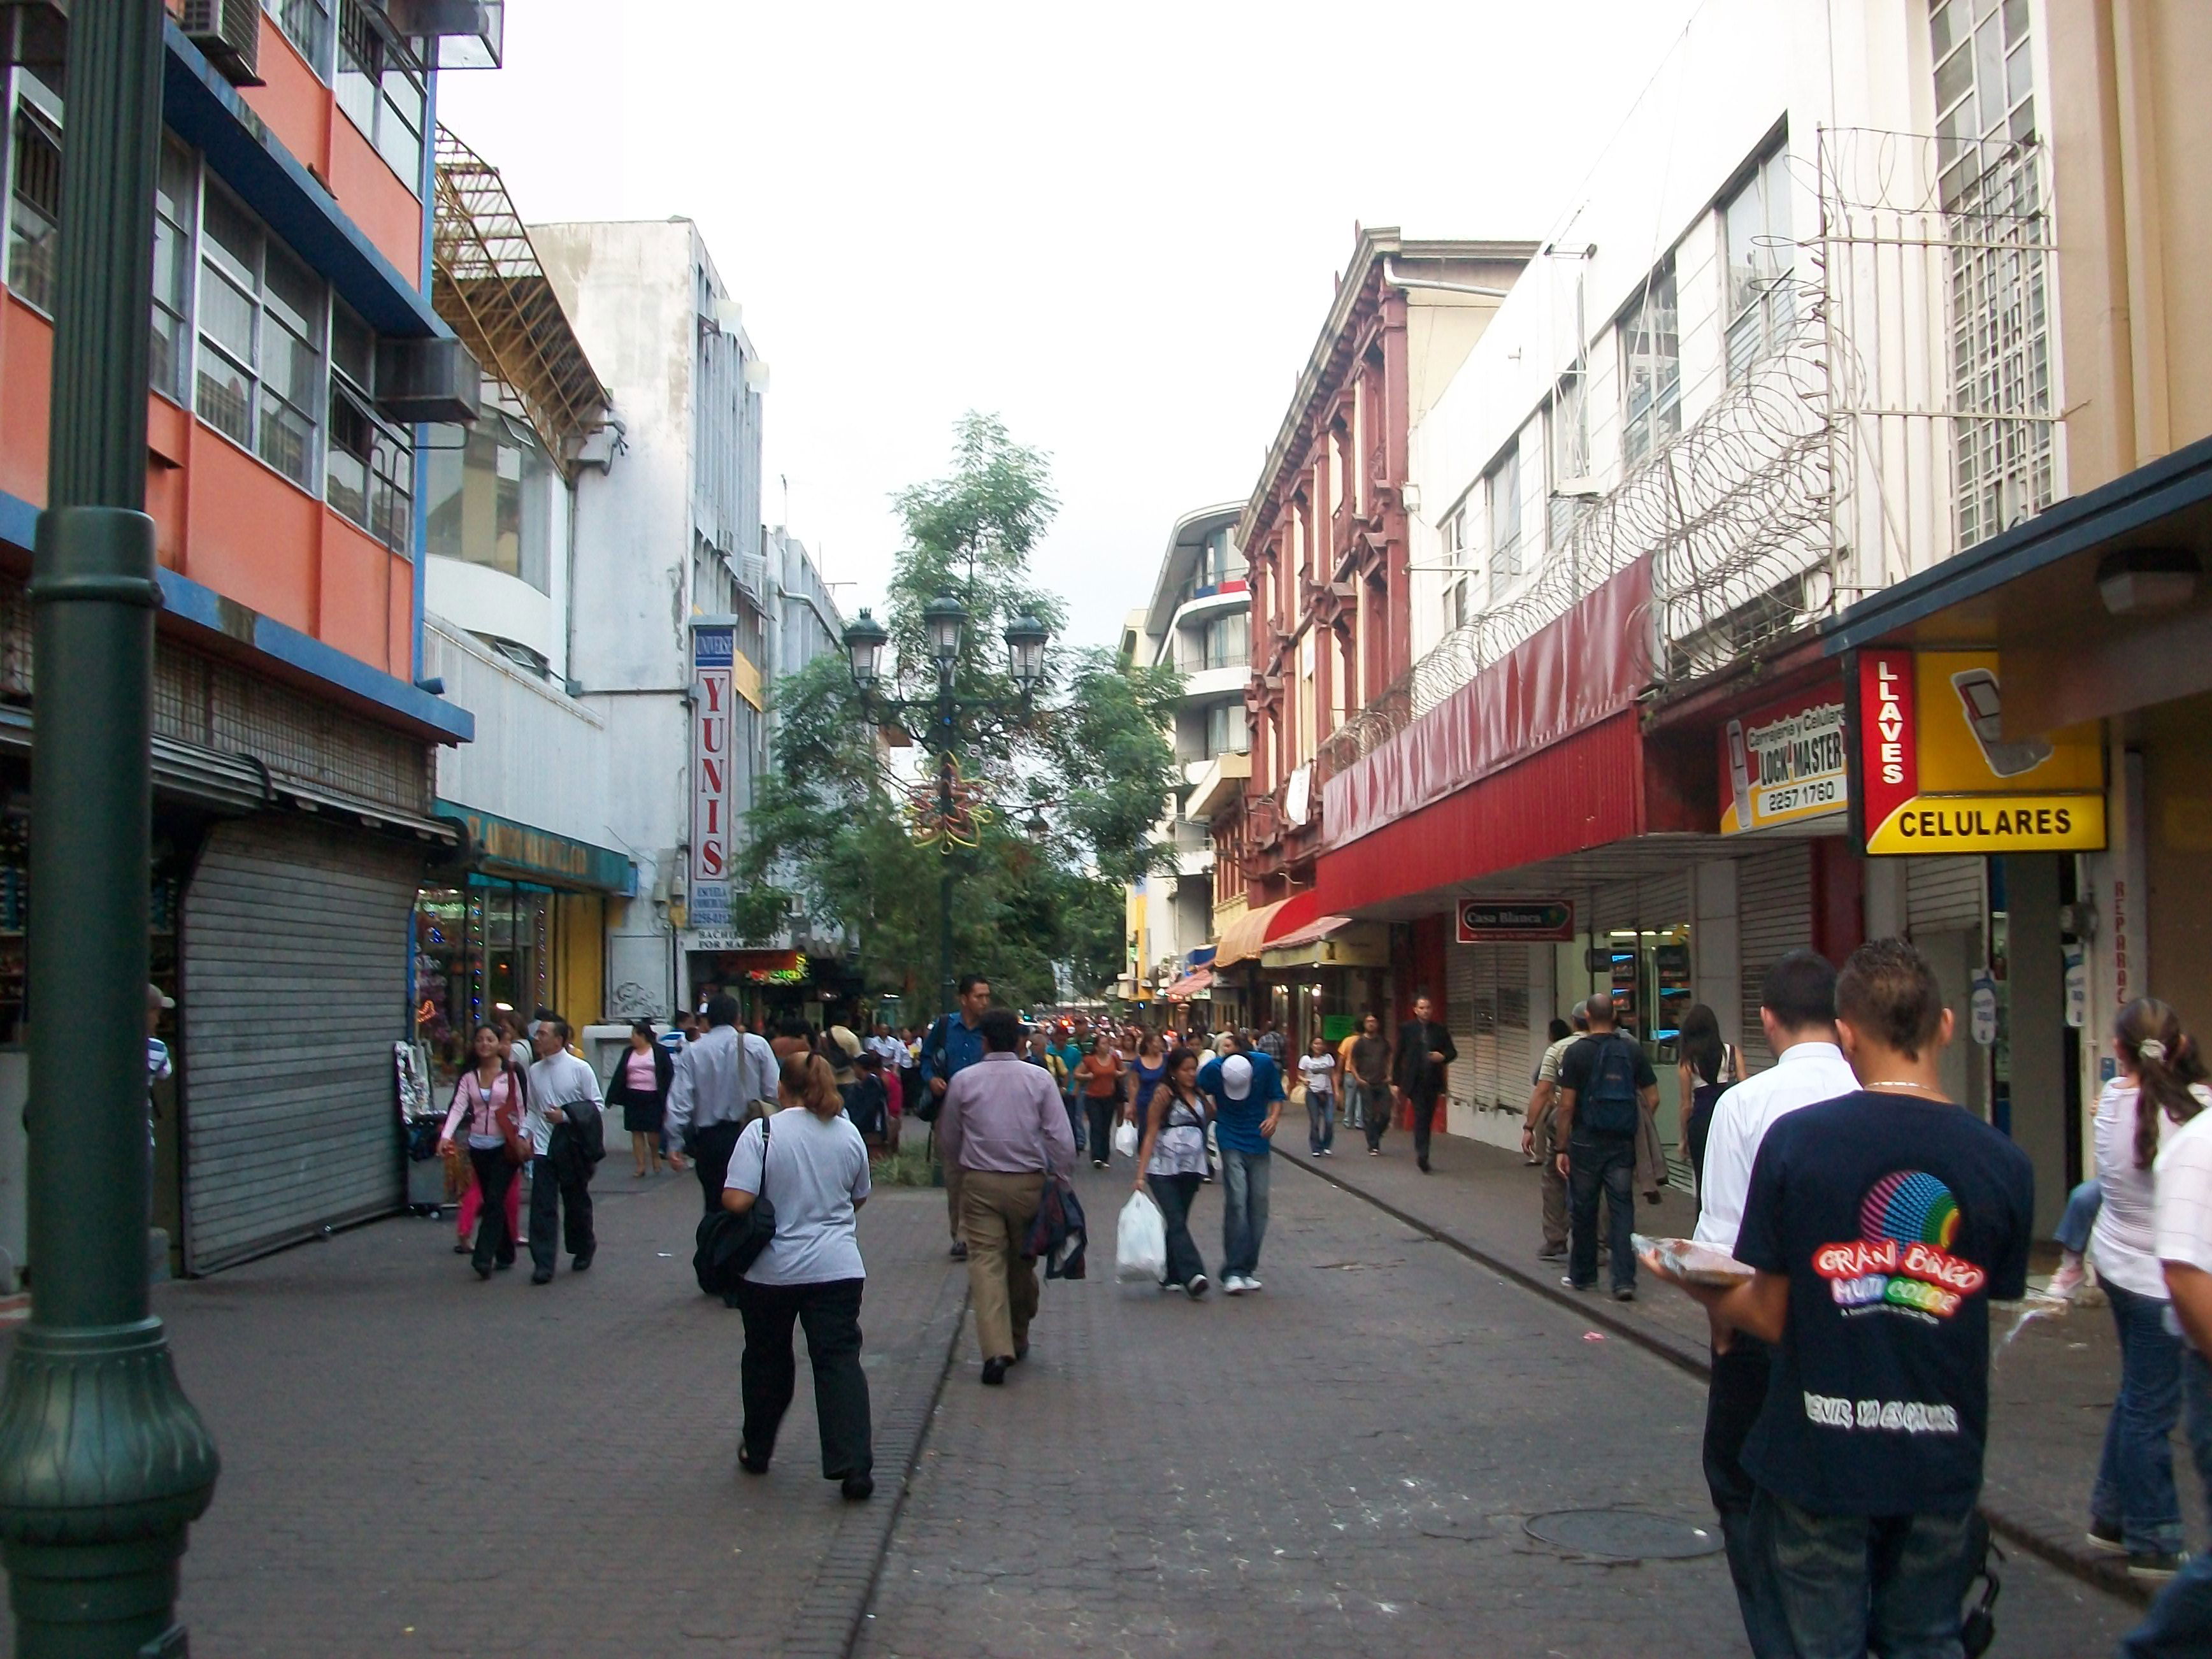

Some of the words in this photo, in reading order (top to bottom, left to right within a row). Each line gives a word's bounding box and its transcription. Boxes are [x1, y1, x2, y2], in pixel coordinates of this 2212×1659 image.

[1878, 661, 1904, 784] LLAVES
[1760, 745, 1789, 786] LOCK
[1793, 731, 1842, 778] MASTER
[701, 677, 724, 876] YUNIS
[1769, 788, 1798, 811] 2257
[1899, 808, 2071, 837] CELULARES
[1467, 911, 1497, 924] Casa
[1499, 910, 1542, 923] Blanca
[698, 940, 721, 949] POR
[1818, 1241, 1897, 1273] GRAN
[1904, 1244, 1984, 1288] BINGO
[1887, 1279, 1962, 1314] COLOR
